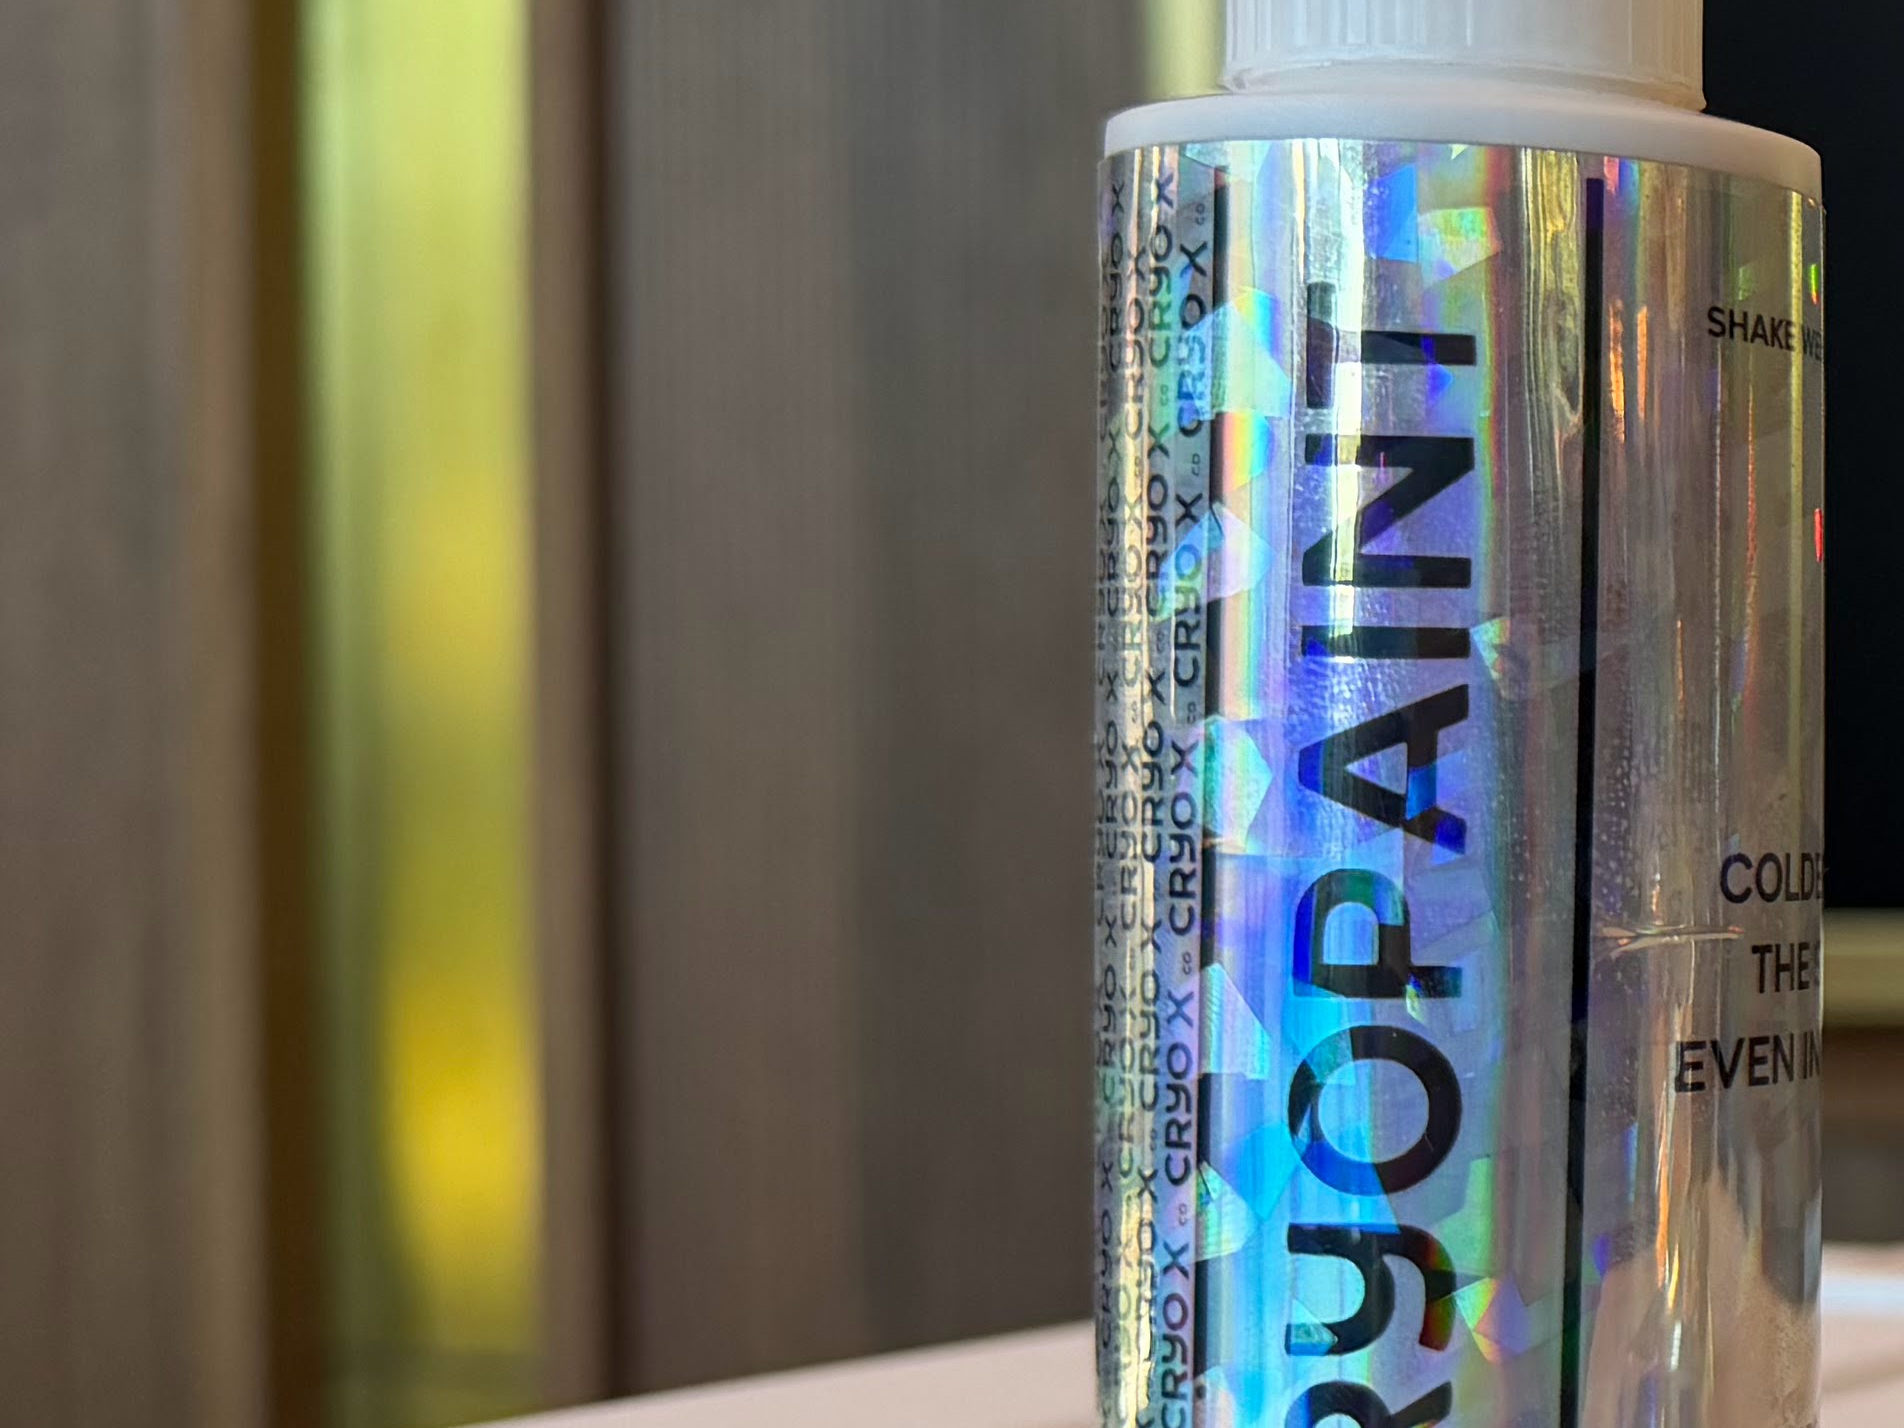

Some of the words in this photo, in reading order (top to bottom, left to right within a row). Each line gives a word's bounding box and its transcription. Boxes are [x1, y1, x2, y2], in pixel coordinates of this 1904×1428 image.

[1112, 181, 1125, 214] X
[1155, 173, 1175, 209] X
[1128, 244, 1147, 283] X
[1180, 241, 1207, 277] X
[1149, 224, 1174, 369] CRYO
[1707, 306, 1797, 351] SHAKE
[1108, 426, 1121, 461] X
[1148, 423, 1171, 460] X
[1176, 492, 1203, 529] X
[1146, 473, 1169, 619] CRYO
[1174, 543, 1201, 688] CRYO
[1106, 671, 1119, 703] X
[1146, 670, 1166, 705] X
[1121, 739, 1140, 776] X
[1171, 739, 1199, 778] X
[1141, 720, 1164, 864] CRYO
[1169, 791, 1197, 937] CRYO
[1105, 915, 1118, 948] X
[1140, 917, 1162, 954] X
[1751, 942, 1810, 994] THE
[1167, 990, 1194, 1029] X
[1138, 969, 1161, 1113] CRYO
[1675, 1033, 1794, 1093] EVEN
[1164, 1042, 1193, 1187] CRYO
[1102, 1160, 1114, 1193] X
[1137, 1166, 1159, 1205] X
[1163, 1239, 1190, 1280] X
